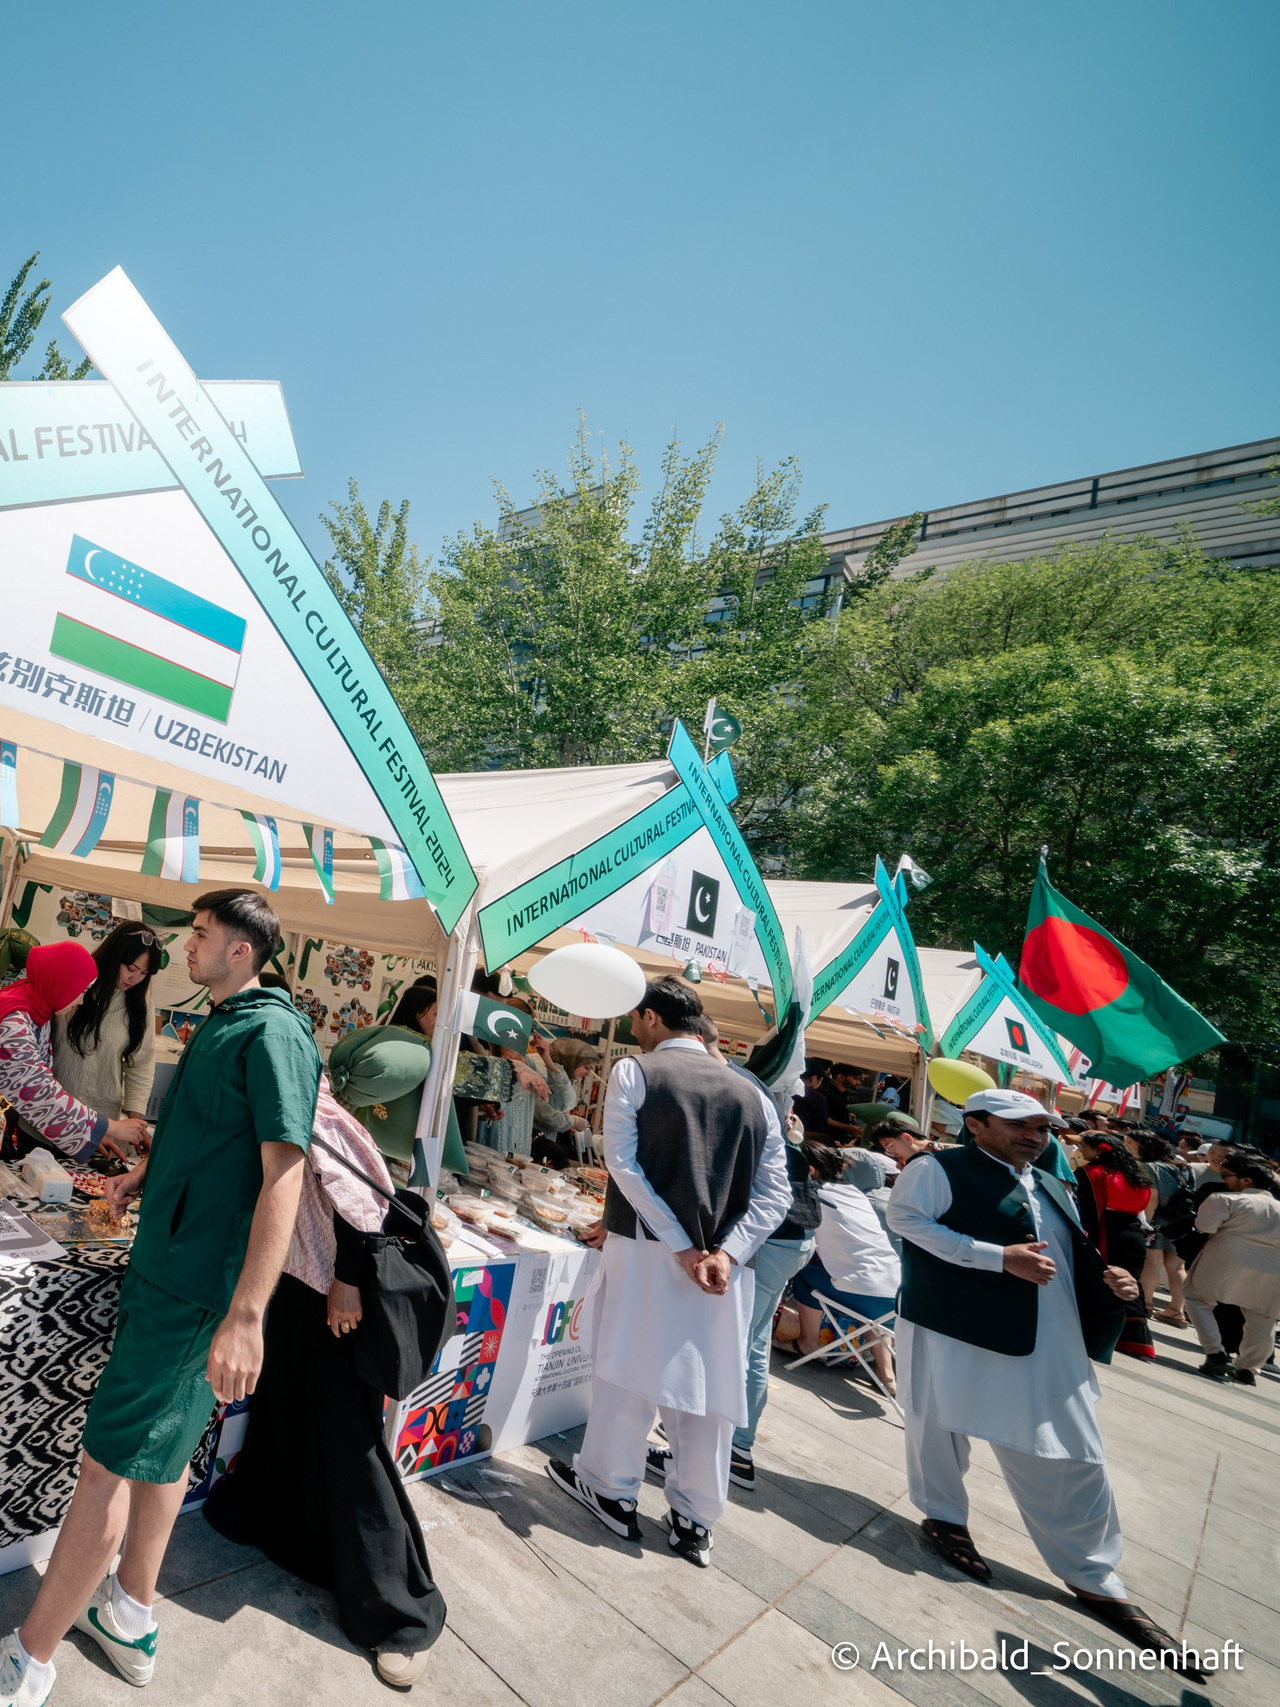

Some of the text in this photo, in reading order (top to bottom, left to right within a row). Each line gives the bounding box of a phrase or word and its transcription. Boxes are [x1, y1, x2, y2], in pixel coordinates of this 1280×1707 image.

[35, 422, 158, 460] FESTIVA
[136, 358, 456, 889] INTERNATIONAL CULTURAL FESTIVAL 2024
[153, 713, 288, 784] UZBEKISTAN
[506, 798, 698, 936] INTERNATIONAL CULTURAL FESTIVA
[689, 761, 744, 873] INTERNATIONAL
[742, 868, 770, 932] CULTURAL
[769, 927, 786, 978] FESTIVAL
[695, 941, 728, 963] PAKISTAN
[537, 1359, 565, 1374] TIANJIN
